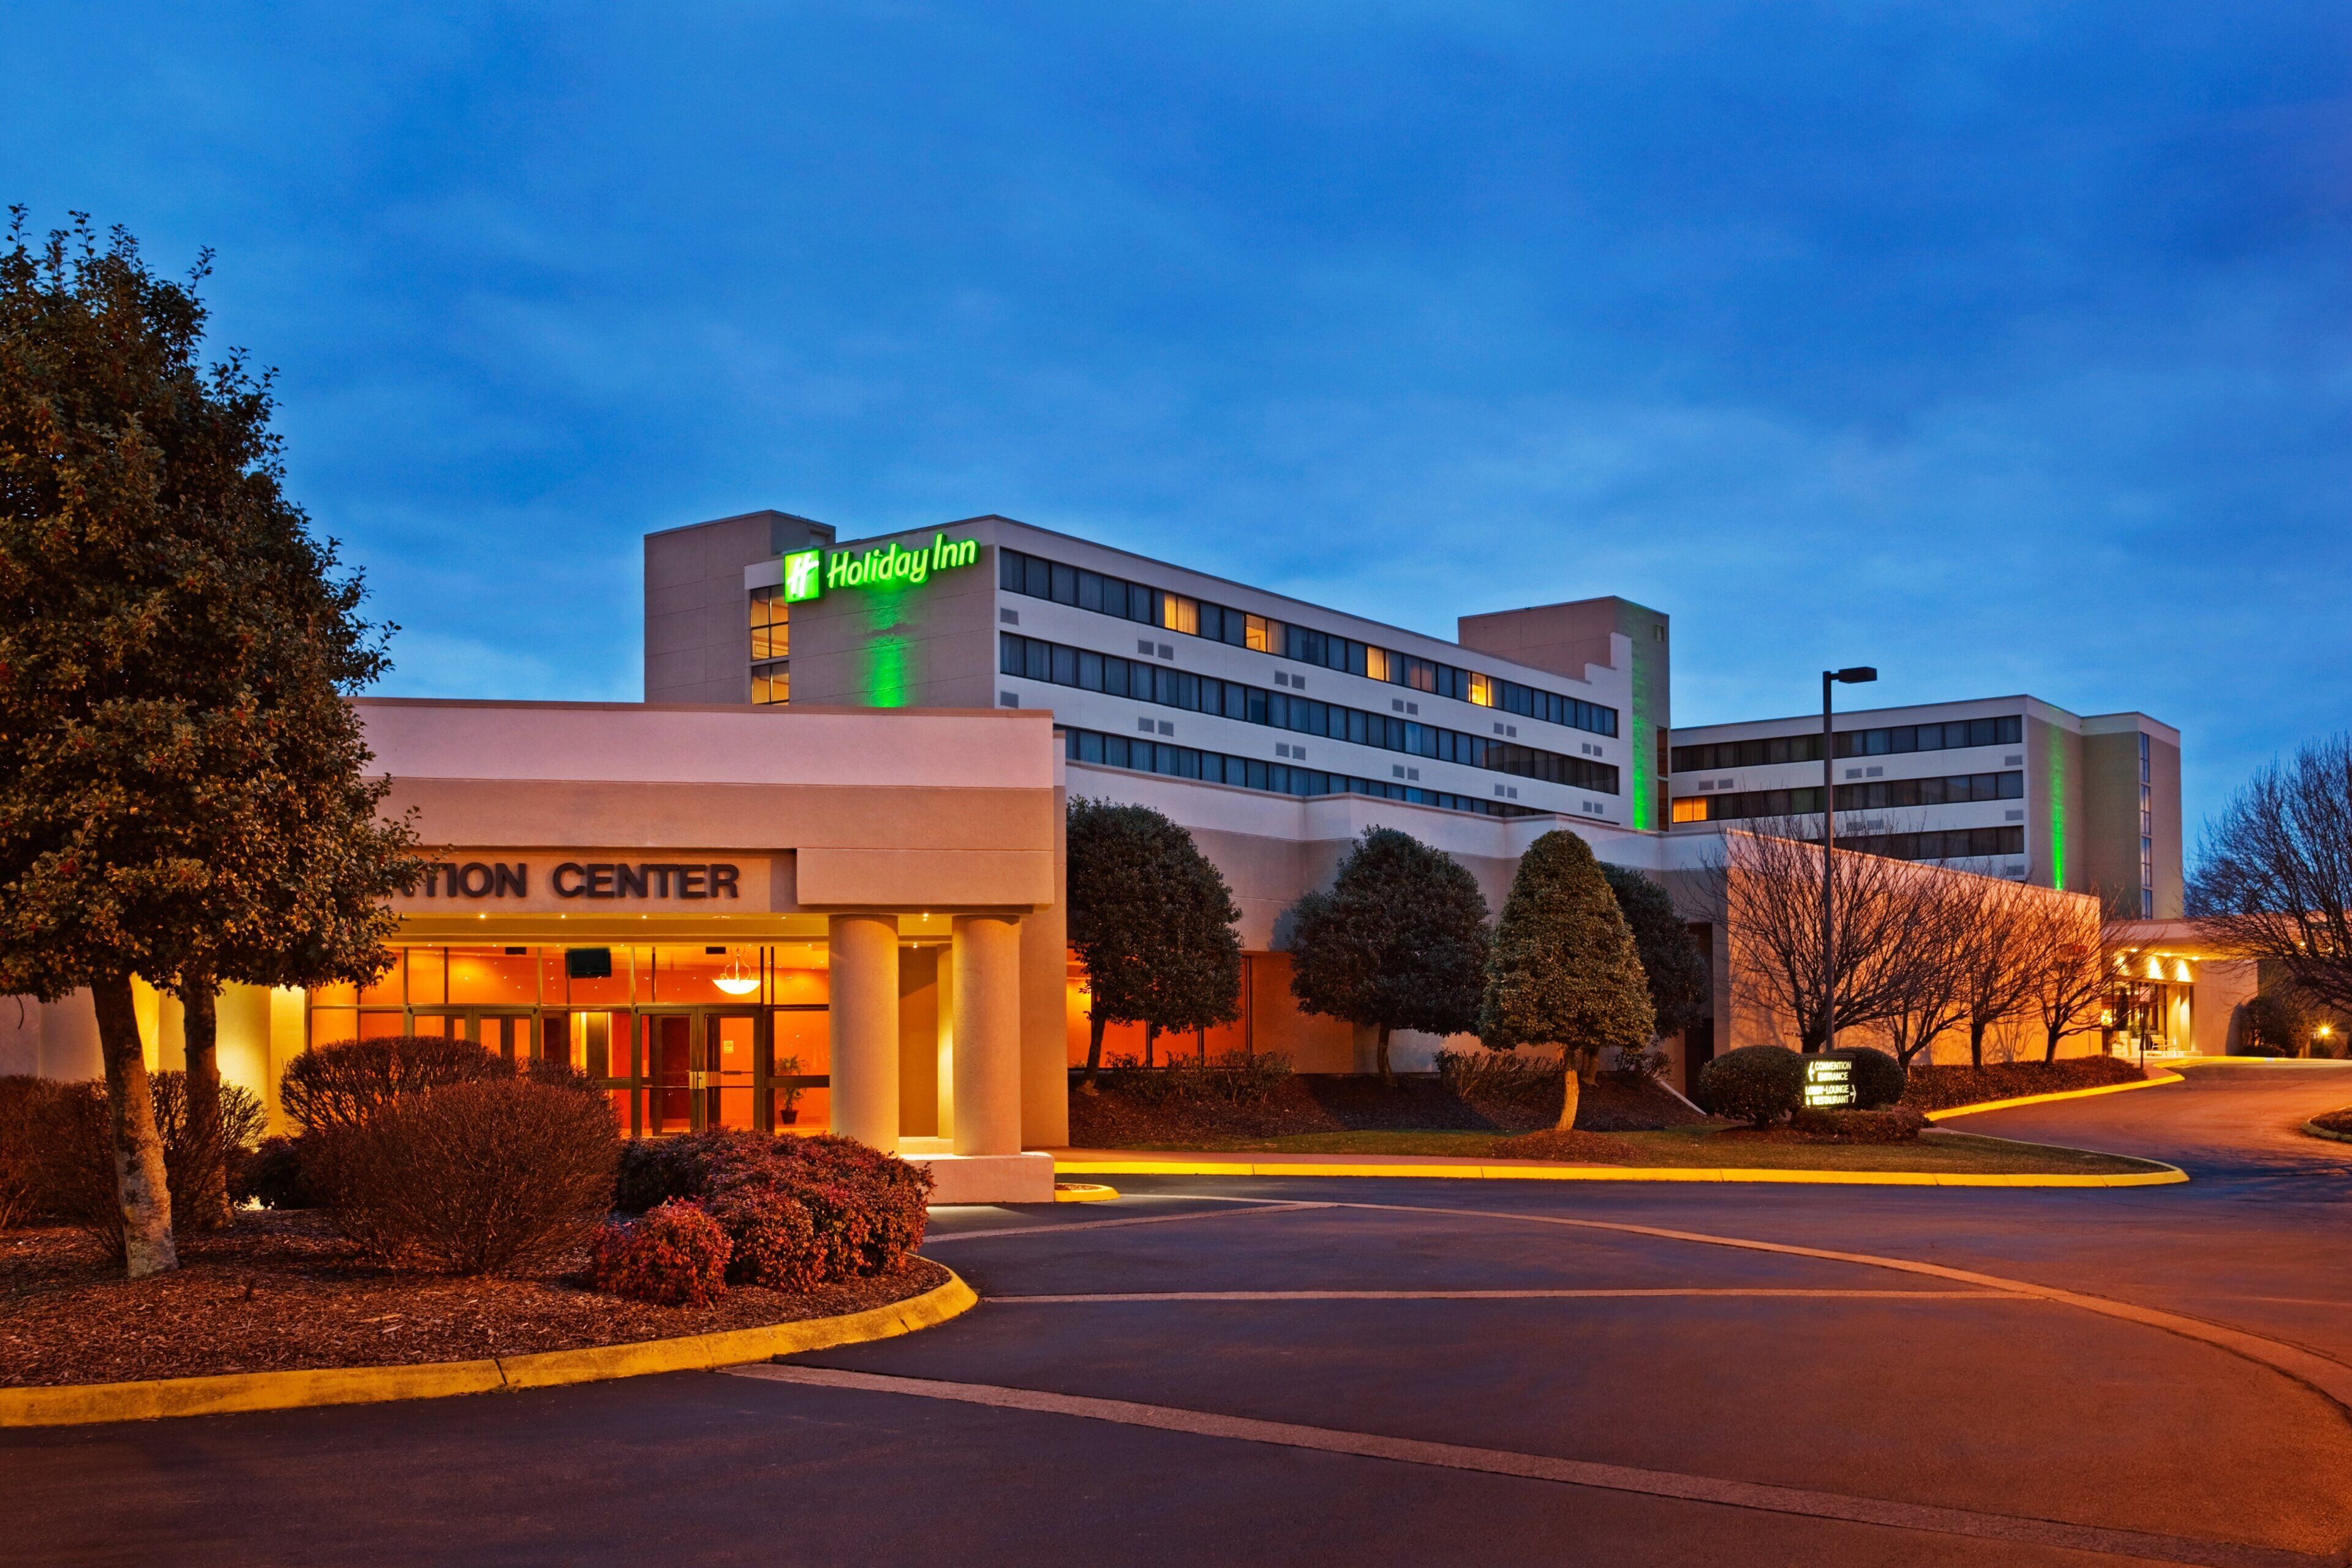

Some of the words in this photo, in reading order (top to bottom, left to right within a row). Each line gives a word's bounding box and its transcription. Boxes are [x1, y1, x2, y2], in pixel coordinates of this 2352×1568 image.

[827, 543, 929, 588] Holiday
[933, 533, 976, 570] Inn
[400, 862, 527, 898] TION
[552, 862, 739, 898] CENTER
[1814, 1061, 1852, 1071] CONVENTION
[1817, 1072, 1849, 1082] ENTRANCE
[1812, 1095, 1849, 1105] RESTAURANT
